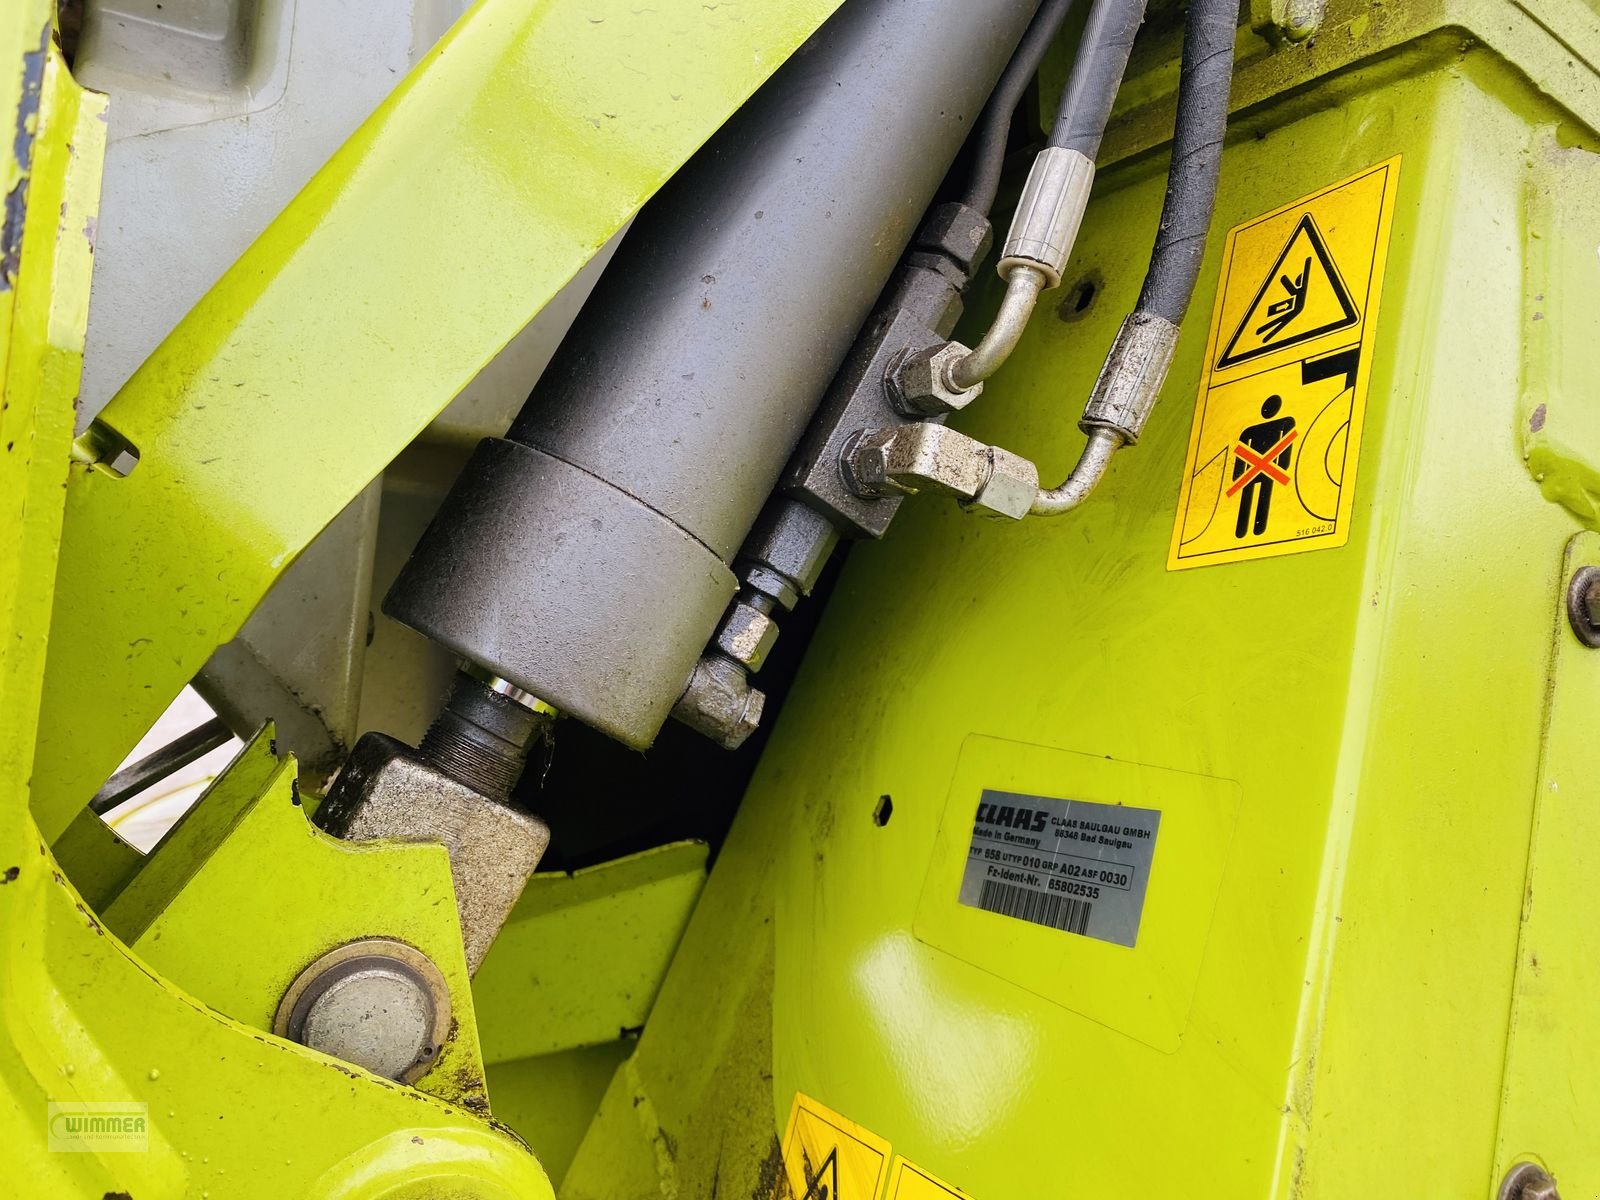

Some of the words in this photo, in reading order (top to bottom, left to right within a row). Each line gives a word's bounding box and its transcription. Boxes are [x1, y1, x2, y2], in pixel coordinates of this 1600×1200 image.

[1296, 528, 1310, 537] 516
[975, 803, 1050, 832] CLAAS
[1051, 817, 1078, 828] CLAAS
[1080, 821, 1120, 834] SAULGAU
[1123, 827, 1151, 839] GMBH
[973, 826, 993, 837] Made
[994, 830, 1002, 839] in
[1004, 832, 1041, 849] Germany
[1080, 833, 1096, 843] Bad
[1098, 835, 1133, 849] Saulgau
[984, 848, 1001, 860] 658
[1002, 853, 1022, 863] UTYP
[1022, 855, 1041, 868] 010
[1042, 861, 1059, 871] GRP
[1060, 864, 1080, 877] A02
[1081, 868, 1099, 878] ASF
[1100, 871, 1127, 886] 0030
[987, 865, 1041, 887] Fz-Ident-Nr.
[1048, 879, 1100, 899] 65802535
